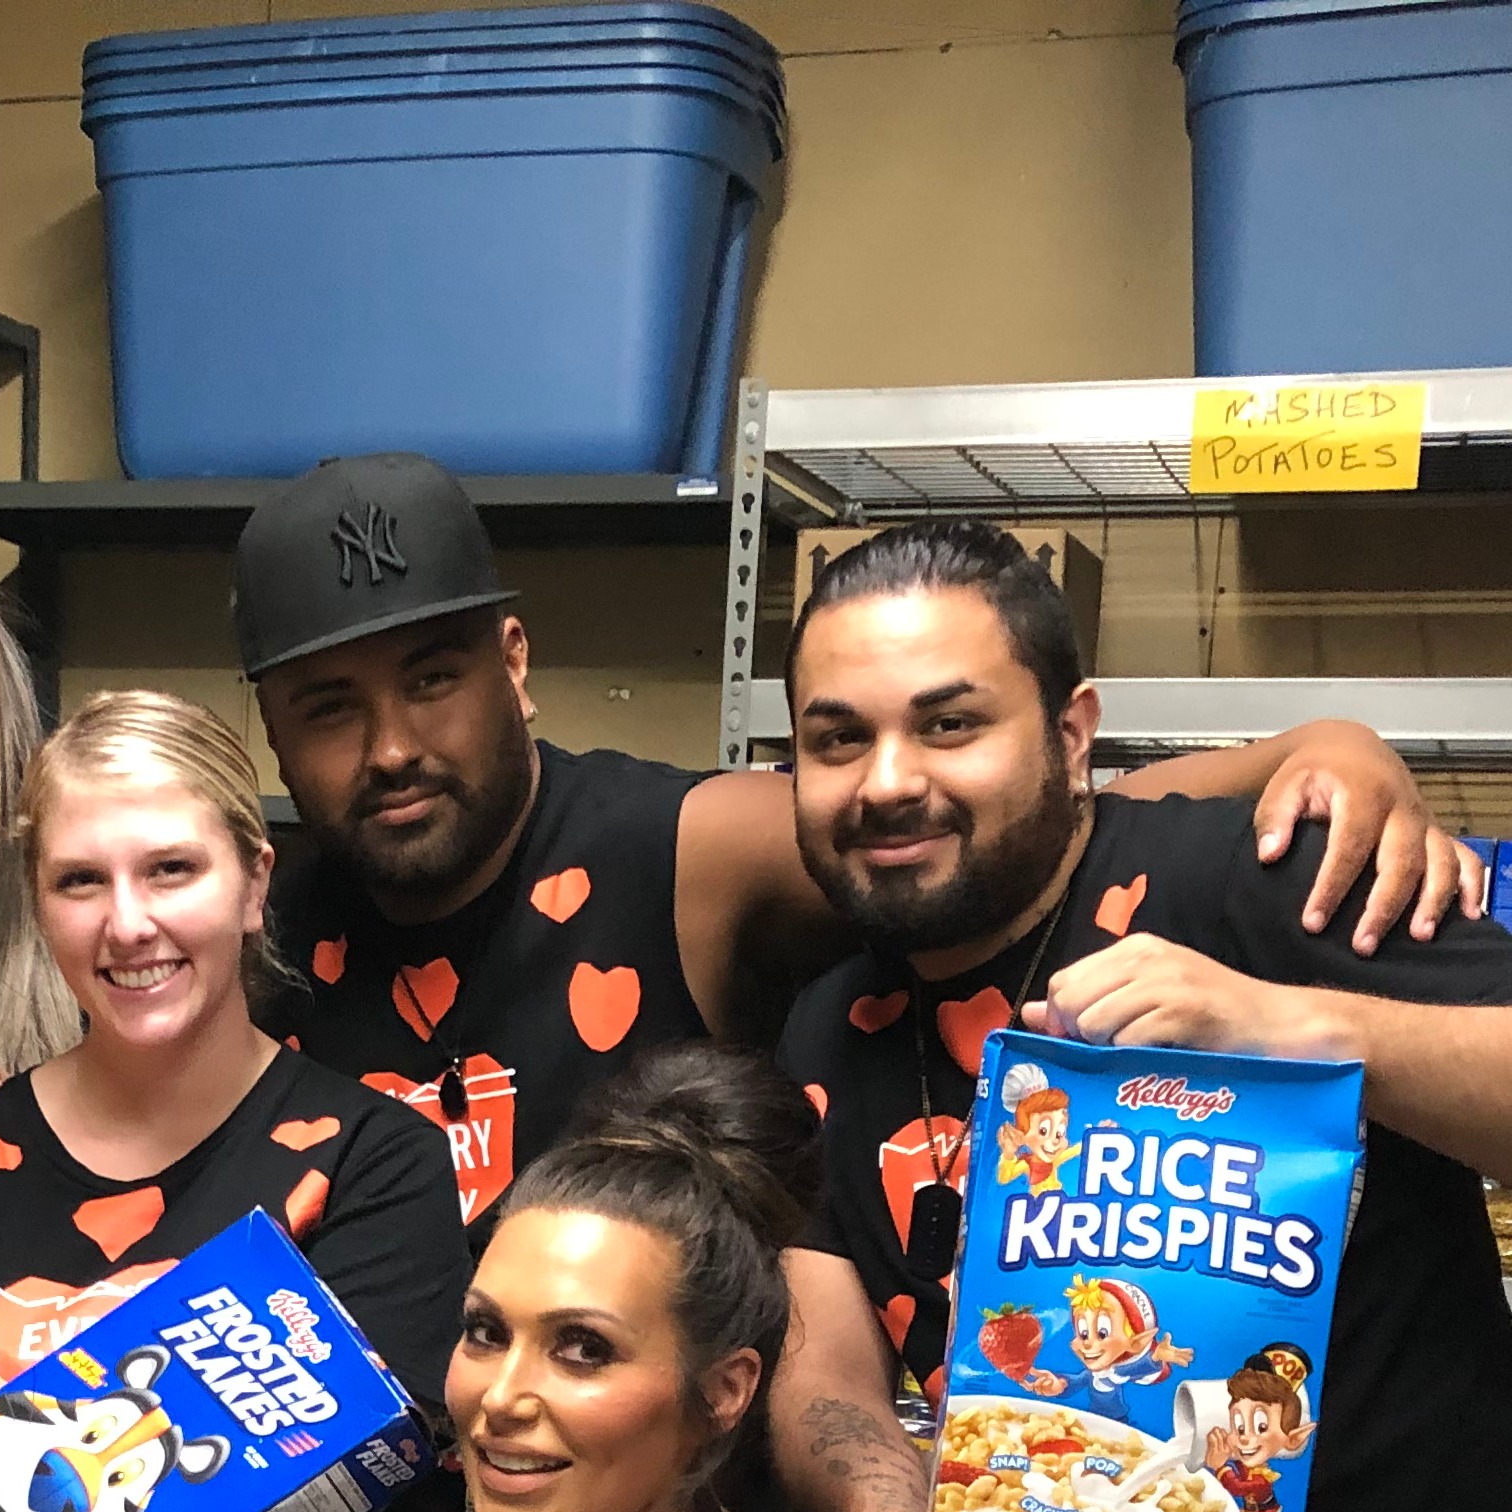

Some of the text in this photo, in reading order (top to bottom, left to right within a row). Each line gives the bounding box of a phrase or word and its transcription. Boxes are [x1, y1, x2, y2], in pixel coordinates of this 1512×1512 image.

[1225, 390, 1397, 428] MASHED
[1203, 430, 1397, 480] POTATOES
[1116, 1074, 1236, 1122] Kellogg's
[1084, 1132, 1258, 1210] RICE
[1004, 1196, 1317, 1291] KRISPIES
[267, 1288, 333, 1365] Kellogg's
[159, 1318, 297, 1437] FLAKES
[188, 1285, 339, 1425] FROSTED
[1272, 1352, 1307, 1383] POP
[356, 1450, 396, 1488] FLAKES
[366, 1438, 418, 1481] FROSTED
[989, 1456, 1030, 1471] SNAP!
[1086, 1457, 1122, 1478] POP!
